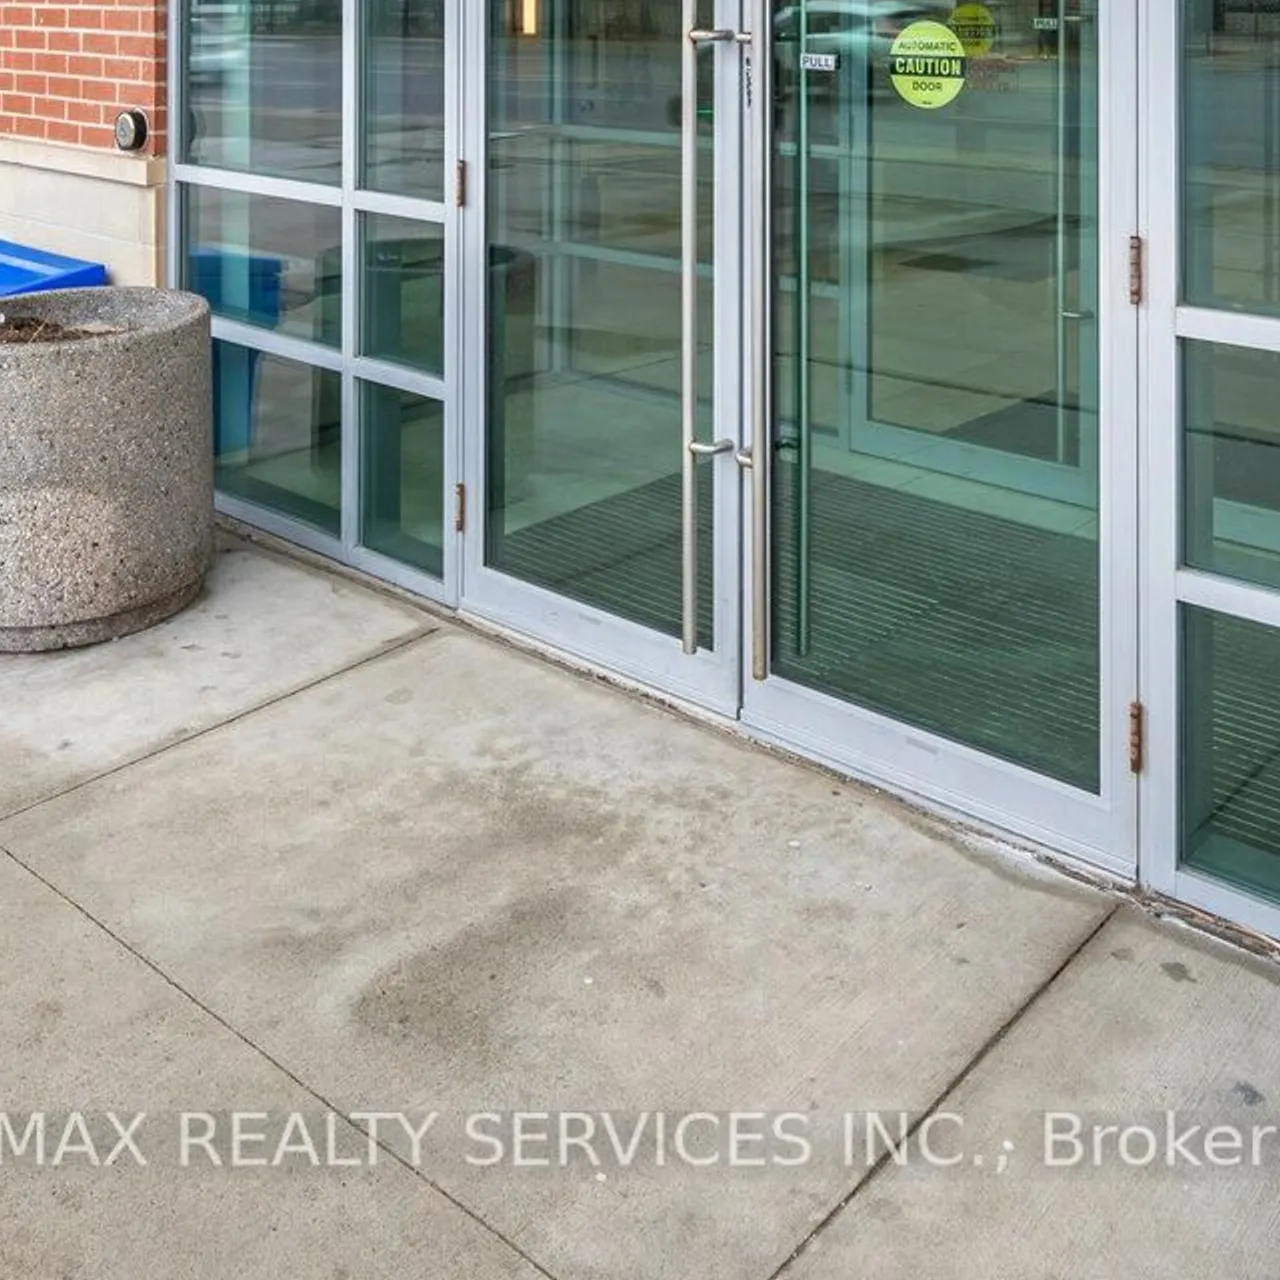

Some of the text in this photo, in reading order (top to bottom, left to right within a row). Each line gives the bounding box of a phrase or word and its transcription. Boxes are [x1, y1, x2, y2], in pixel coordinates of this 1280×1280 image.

[898, 41, 957, 52] AUTOMATIC
[802, 56, 832, 67] PULL
[895, 57, 961, 75] CAUTION
[912, 81, 943, 91] DOOR
